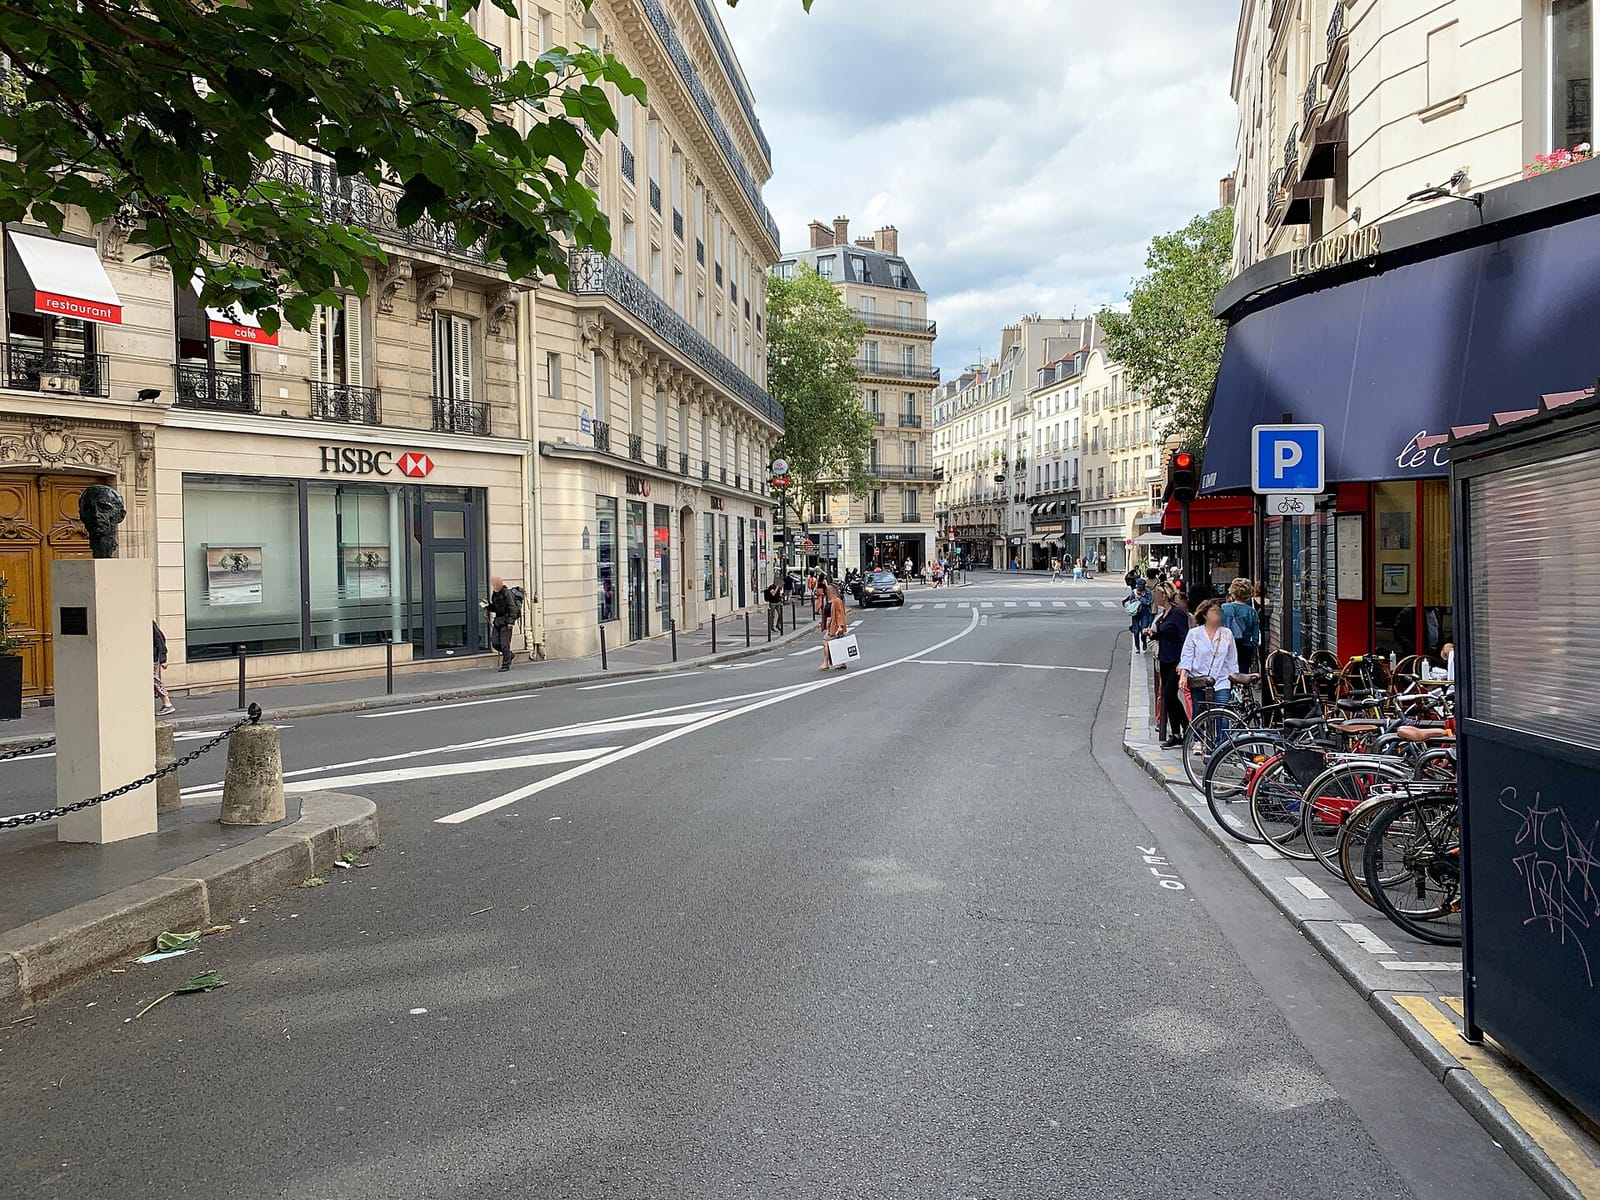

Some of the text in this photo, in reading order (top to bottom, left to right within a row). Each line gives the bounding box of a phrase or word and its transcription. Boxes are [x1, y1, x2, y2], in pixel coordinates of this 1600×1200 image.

[1290, 223, 1379, 276] LE COMPTOIR
[46, 299, 111, 318] restaurant
[234, 327, 256, 339] café
[319, 446, 392, 475] HSBC
[1274, 440, 1303, 479] P
